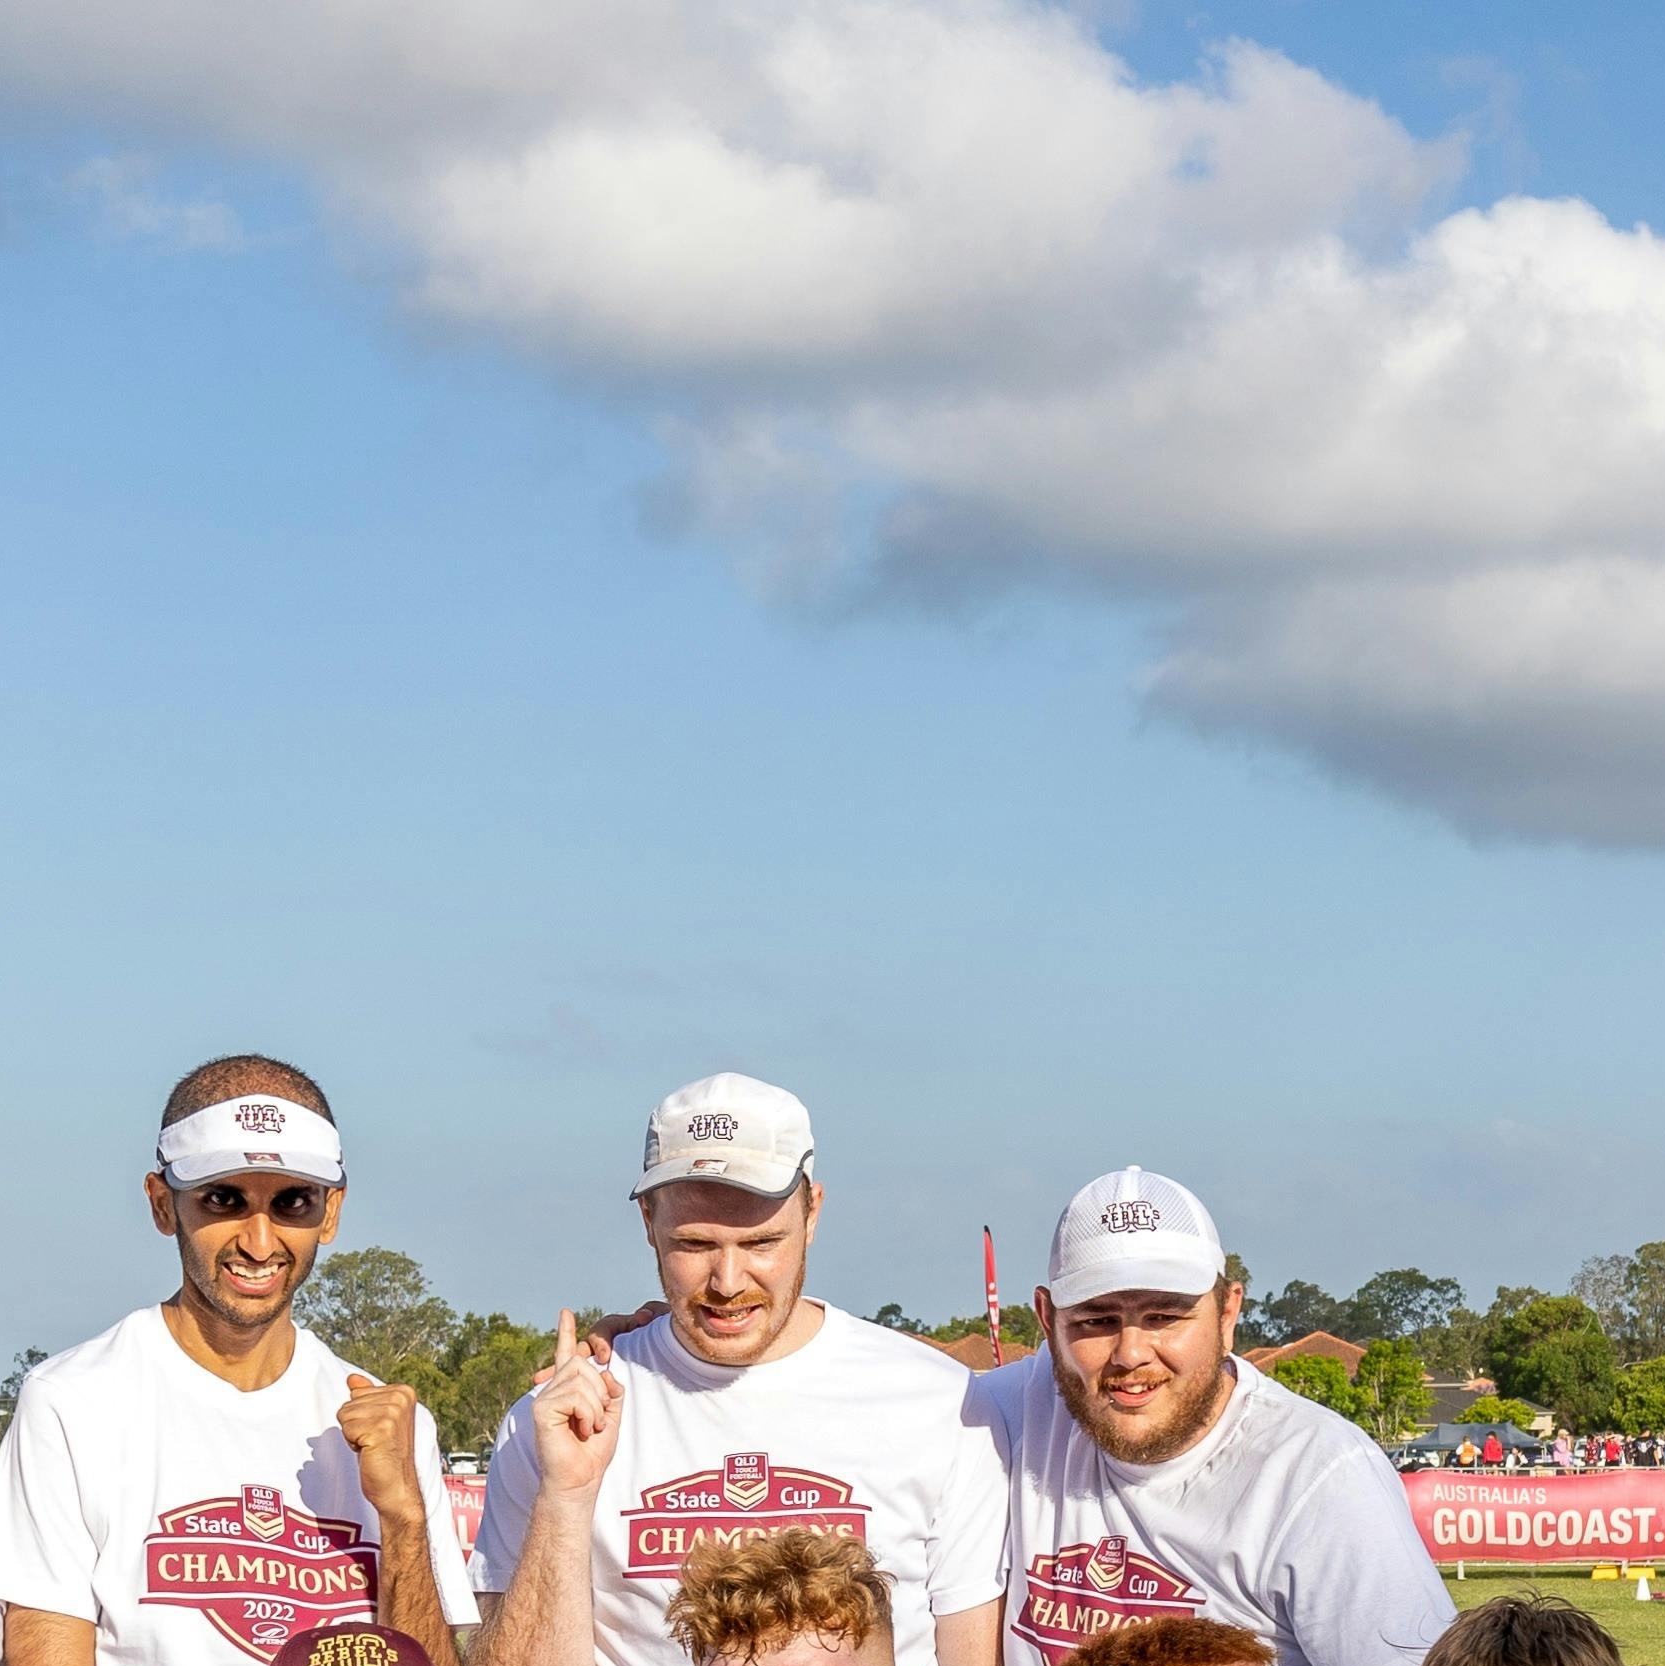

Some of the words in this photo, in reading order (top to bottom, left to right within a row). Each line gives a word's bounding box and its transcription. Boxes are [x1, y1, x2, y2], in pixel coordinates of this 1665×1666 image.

[734, 1457, 758, 1467] QLD
[252, 1488, 273, 1499] QLD
[665, 1491, 721, 1509] State
[780, 1487, 821, 1508] Cup
[1432, 1483, 1547, 1504] AUSTRALIA'S
[185, 1515, 242, 1535] State
[293, 1530, 330, 1553] Cup
[158, 1553, 369, 1595] CHAMPIONS
[1129, 1575, 1158, 1598] Cup
[243, 1601, 296, 1622] 2022
